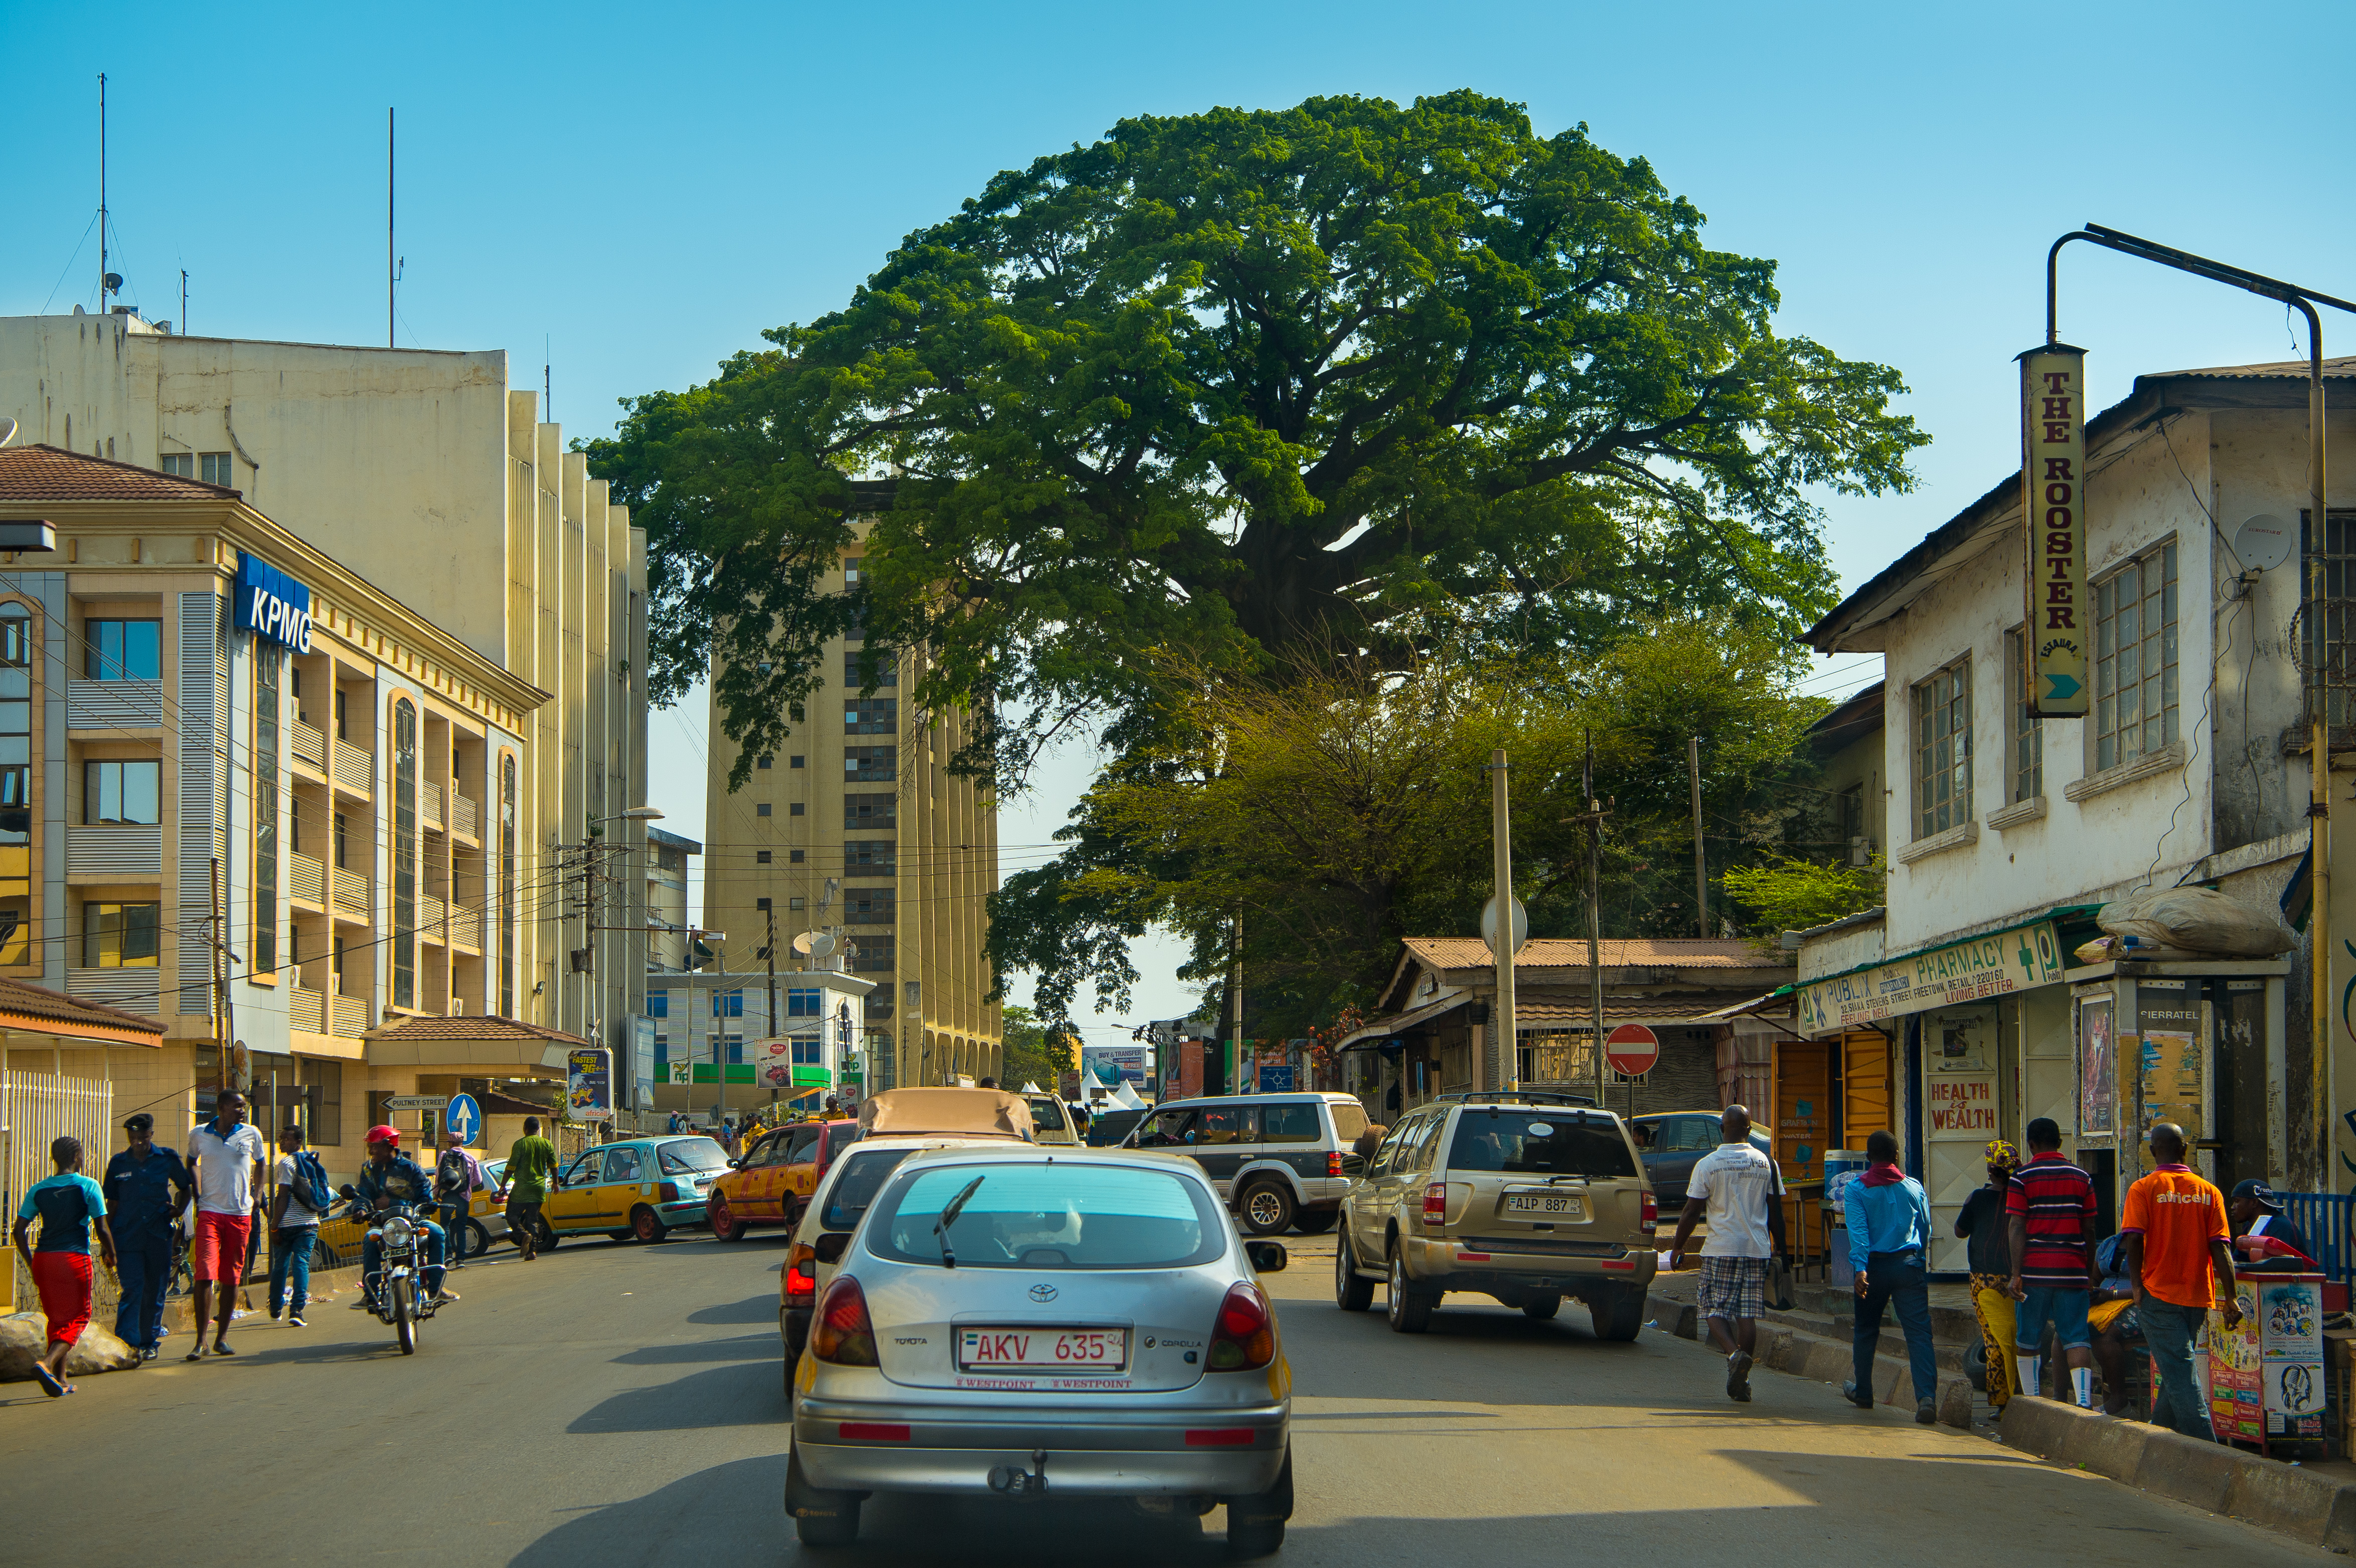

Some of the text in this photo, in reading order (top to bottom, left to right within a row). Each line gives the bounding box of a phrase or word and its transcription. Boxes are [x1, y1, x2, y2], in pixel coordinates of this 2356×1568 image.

[2042, 372, 2071, 443] THE
[2044, 458, 2076, 629] ROOSTER
[250, 586, 312, 655] KPMG
[1916, 937, 2005, 983] PHARMACY
[1882, 965, 1901, 980] Publix
[1826, 974, 1872, 1005] PUBLIX
[1880, 976, 1910, 994] PHARMACY
[1866, 996, 1889, 1009] STEVENS
[1945, 987, 1974, 1004] LIVING
[1840, 1011, 1869, 1025] FEELING
[2141, 1011, 2198, 1019] SIERRATEL
[1115, 1049, 1141, 1057] TRANSFER
[1932, 1083, 1989, 1101] HEALTH
[1949, 1100, 1967, 1109] is
[1932, 1109, 1995, 1129] WEALTH
[1516, 1198, 1567, 1211] AIP 887
[2157, 1190, 2211, 1205] africell
[977, 1334, 1105, 1360] AKV 635
[967, 1379, 1132, 1389] WESTPOINT WESTPOINT
